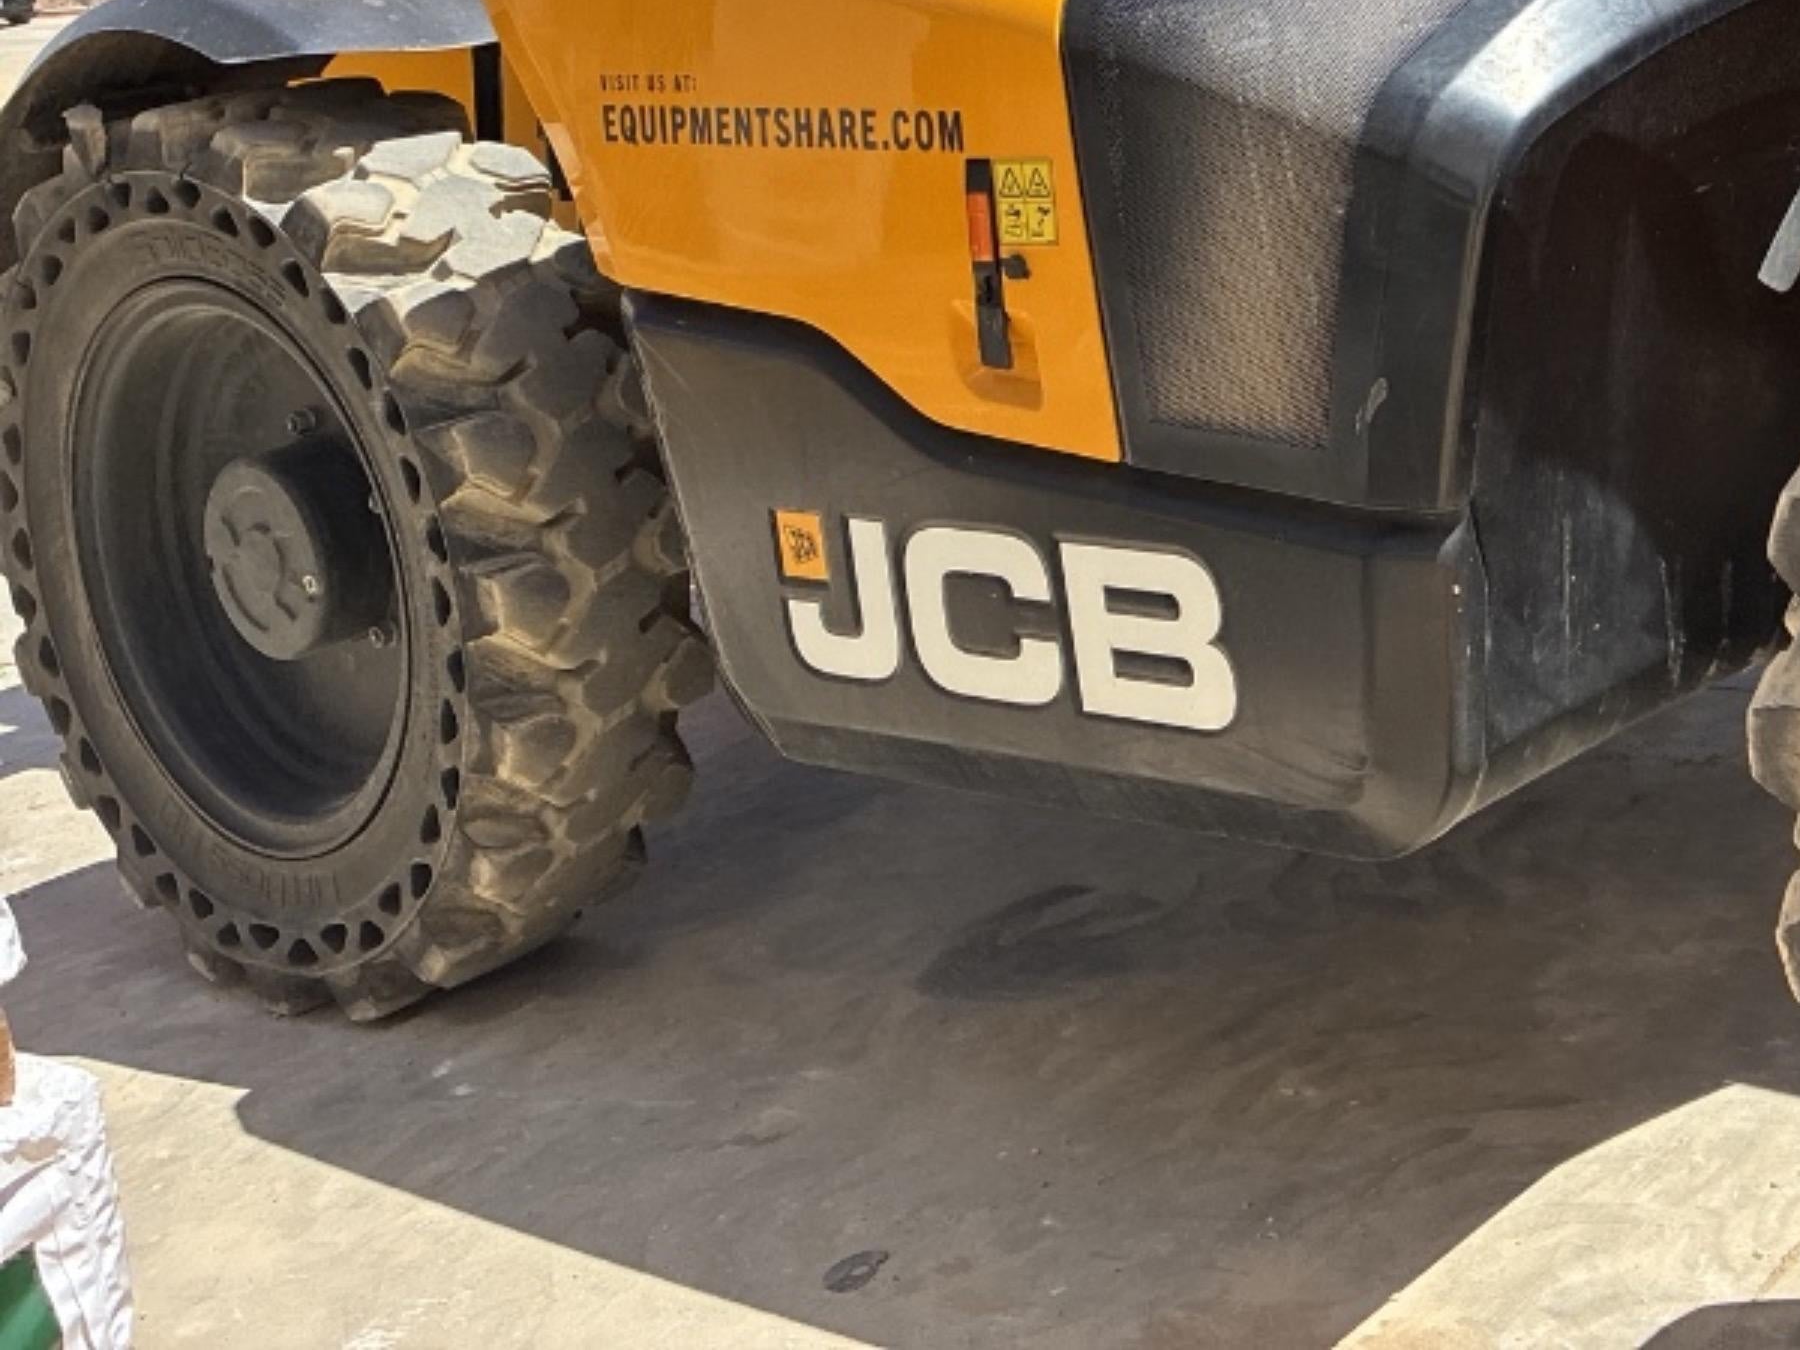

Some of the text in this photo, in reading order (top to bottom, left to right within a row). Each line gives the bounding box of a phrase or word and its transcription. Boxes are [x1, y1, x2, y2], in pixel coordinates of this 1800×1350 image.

[600, 74, 697, 93] VISIT US AT:
[602, 104, 965, 152] EQUIPMENTSHARE.COM
[788, 517, 1238, 731] JCB
